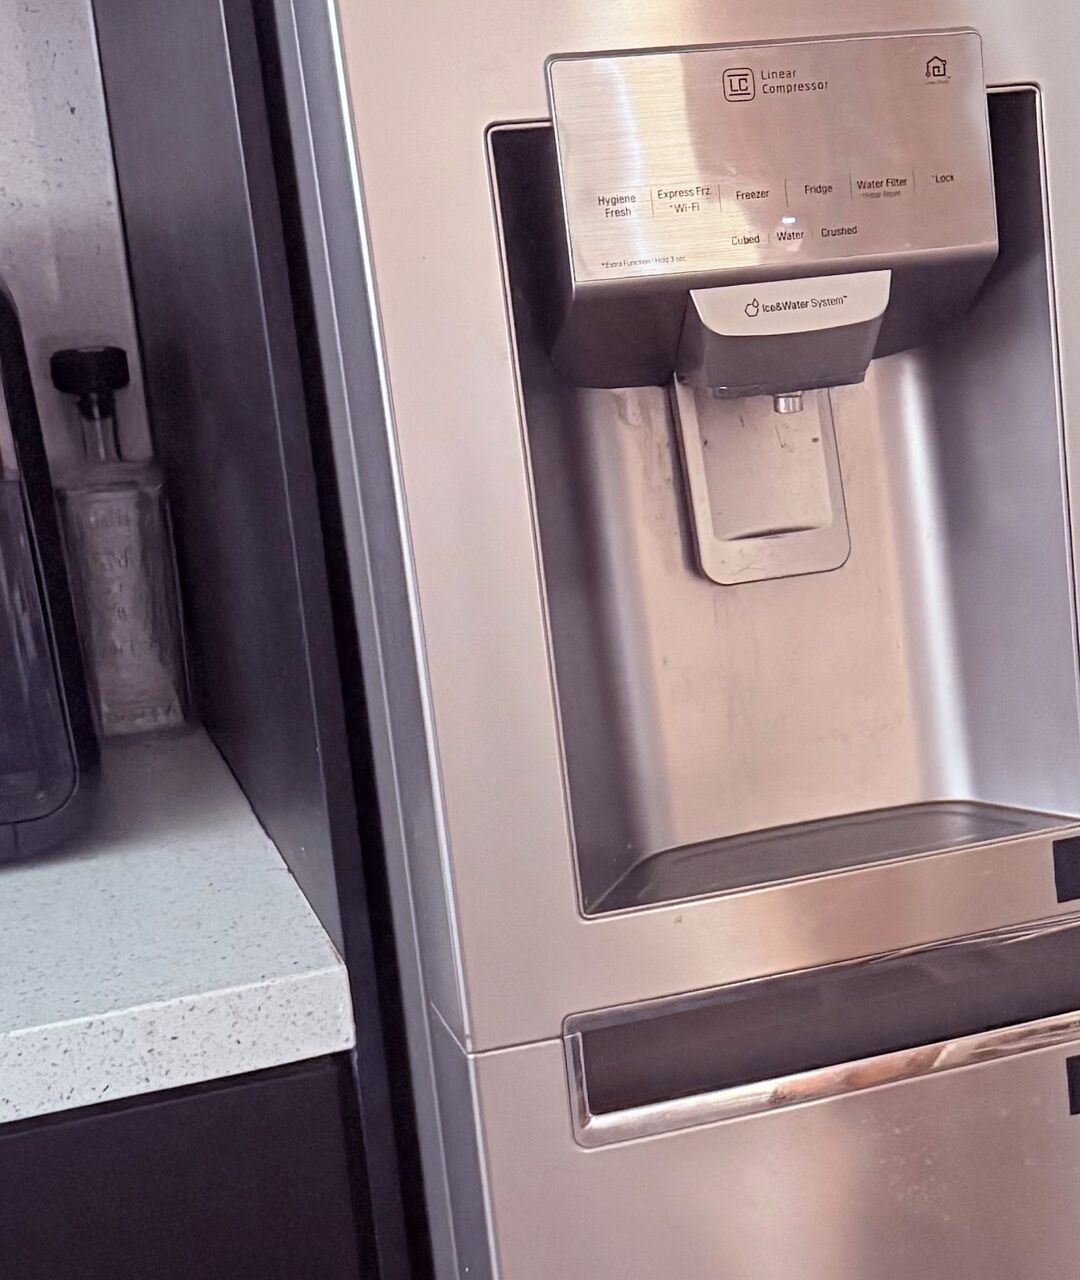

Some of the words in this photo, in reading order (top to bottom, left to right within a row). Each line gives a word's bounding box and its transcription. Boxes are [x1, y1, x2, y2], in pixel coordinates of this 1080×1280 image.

[761, 70, 797, 80] Linear
[762, 80, 829, 95] Compressor
[804, 184, 833, 196] Fridge
[856, 180, 884, 190] Water
[657, 189, 694, 200] Express
[696, 186, 711, 197] Frz
[736, 189, 770, 200] Freezer
[598, 193, 636, 207] Hygiene
[605, 207, 632, 218] Fresh
[776, 230, 805, 241] Water
[820, 225, 858, 238] Crushed
[731, 234, 760, 246] Cubed
[762, 300, 809, 313] Ice&Water
